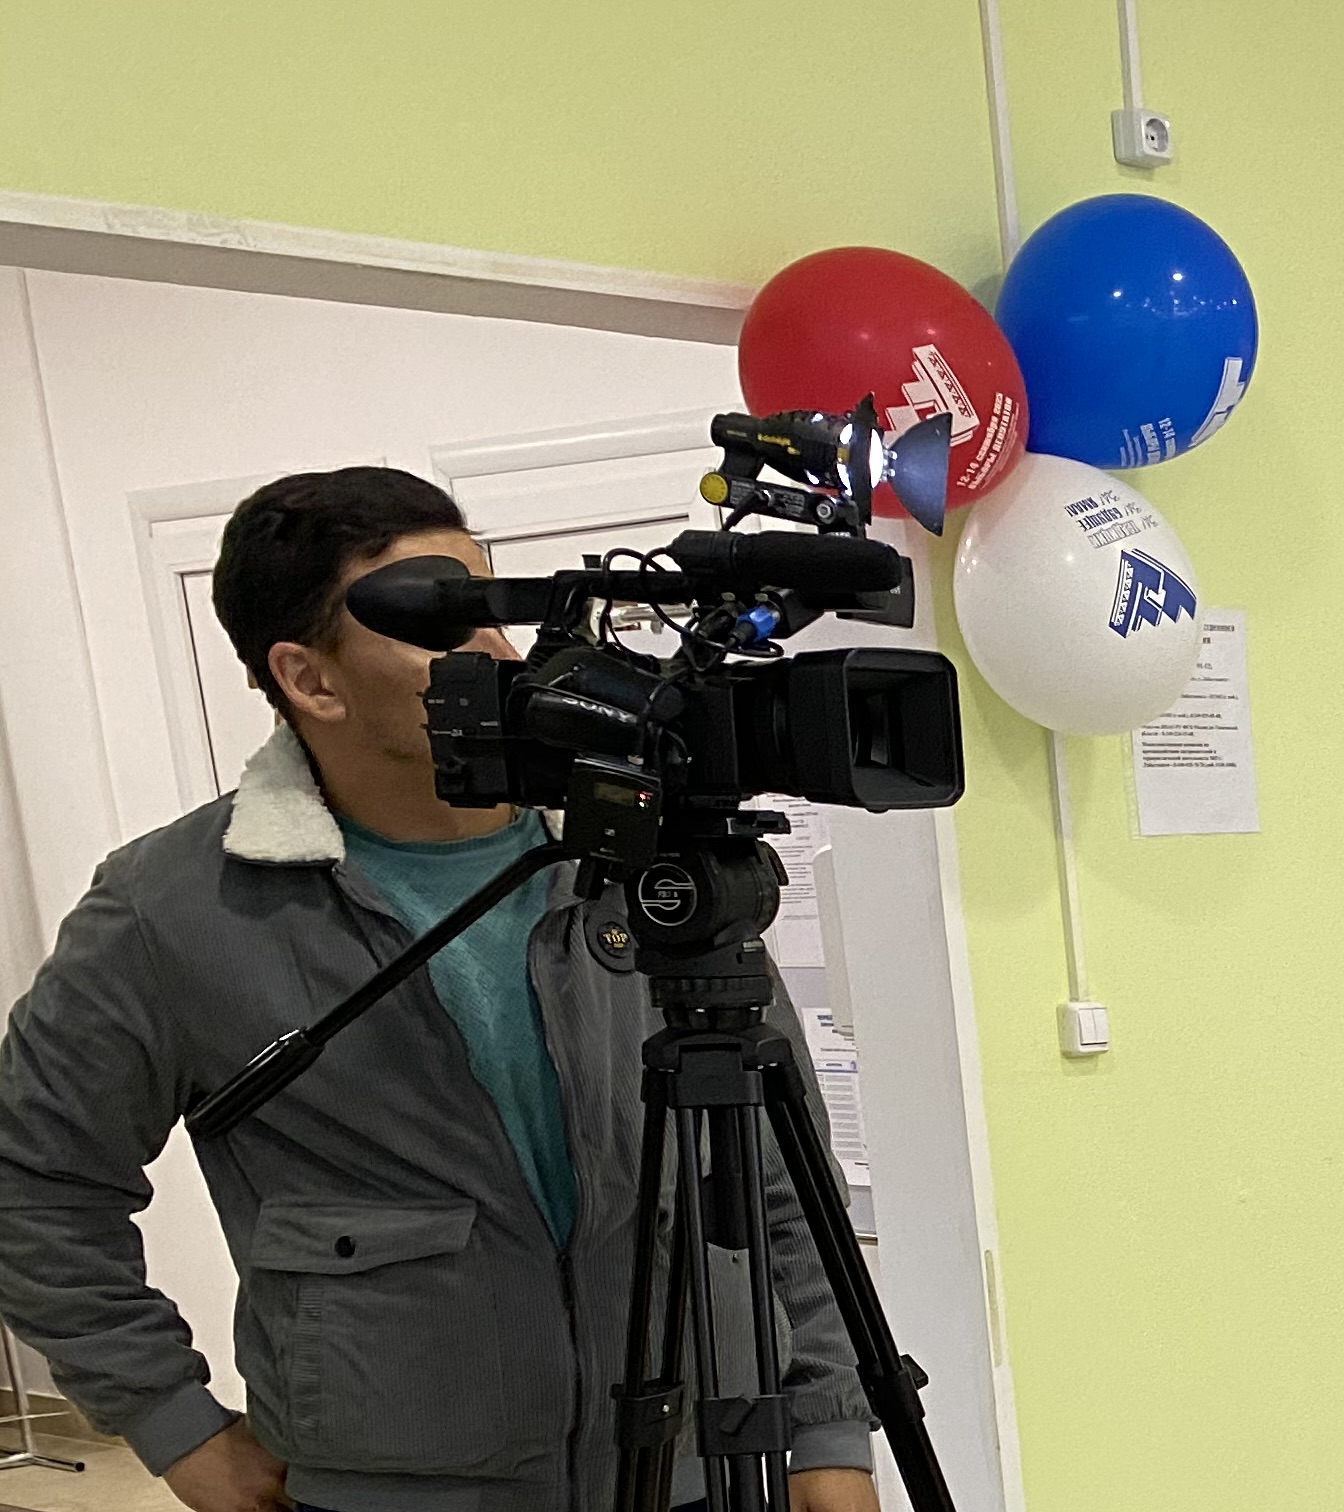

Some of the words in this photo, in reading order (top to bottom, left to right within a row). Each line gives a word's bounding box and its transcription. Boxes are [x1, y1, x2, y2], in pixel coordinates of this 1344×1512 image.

[1158, 417, 1176, 439] 12-14
[956, 461, 979, 486] 12-14
[1064, 496, 1099, 518] ЯМАЛ!
[1075, 507, 1124, 533] БУДУЩЕЕ
